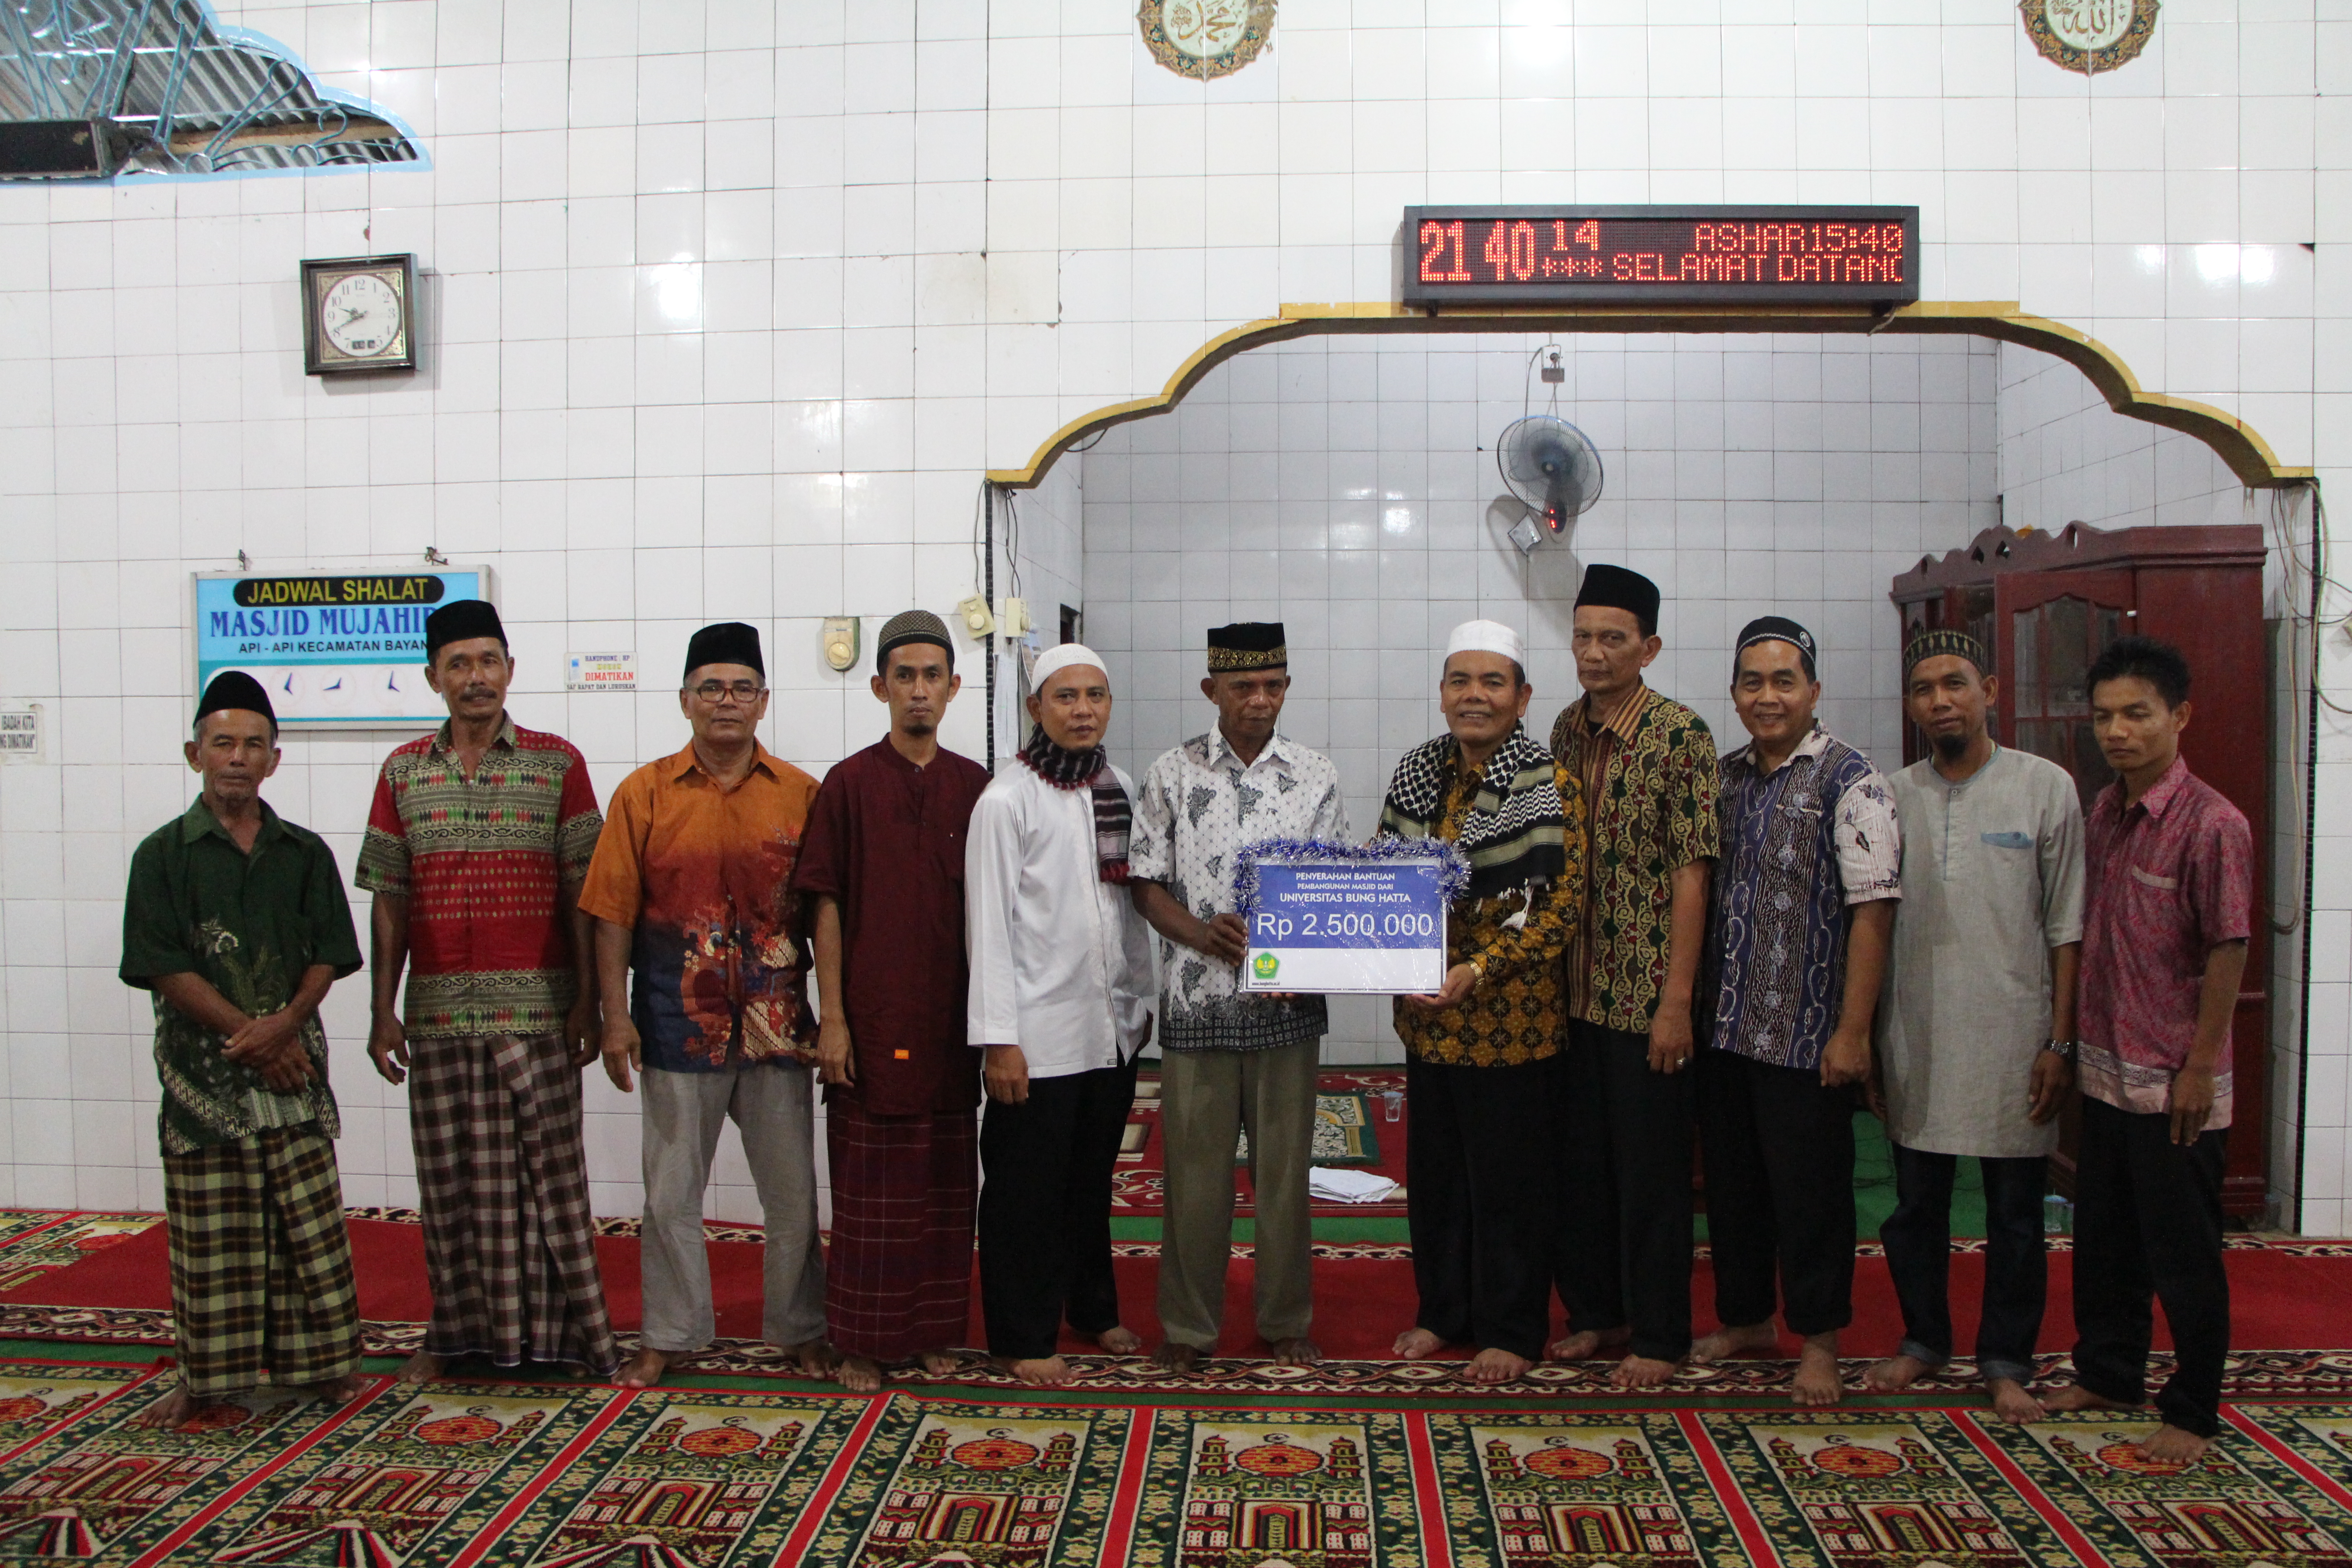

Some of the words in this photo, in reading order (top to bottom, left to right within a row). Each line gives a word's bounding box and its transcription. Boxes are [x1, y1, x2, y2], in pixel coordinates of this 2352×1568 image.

[1553, 220, 1598, 251] 14
[1421, 220, 1471, 282] 21
[1485, 220, 1534, 282] 40
[1613, 253, 1768, 282] SELAMAT
[342, 284, 349, 295] 11
[354, 279, 365, 290] 12
[373, 283, 376, 293] 1
[332, 296, 341, 307] 10
[383, 292, 390, 303] 2
[328, 311, 335, 323] 9
[388, 308, 395, 319] 3
[333, 327, 340, 338] 8
[247, 581, 337, 604] JADWAL
[343, 578, 428, 601] SHALAT
[210, 609, 309, 637] MASJID
[239, 642, 260, 654] API
[274, 642, 294, 653] API
[298, 640, 380, 652] KECAMATAN
[585, 672, 634, 681] DIMATIKAN
[1280, 893, 1343, 902] UNIVERSITAS
[1346, 893, 1376, 902] BUNG
[1379, 893, 1411, 902] HATTA
[1257, 913, 1293, 940] Rp
[1302, 913, 1433, 936] 2.500.000
